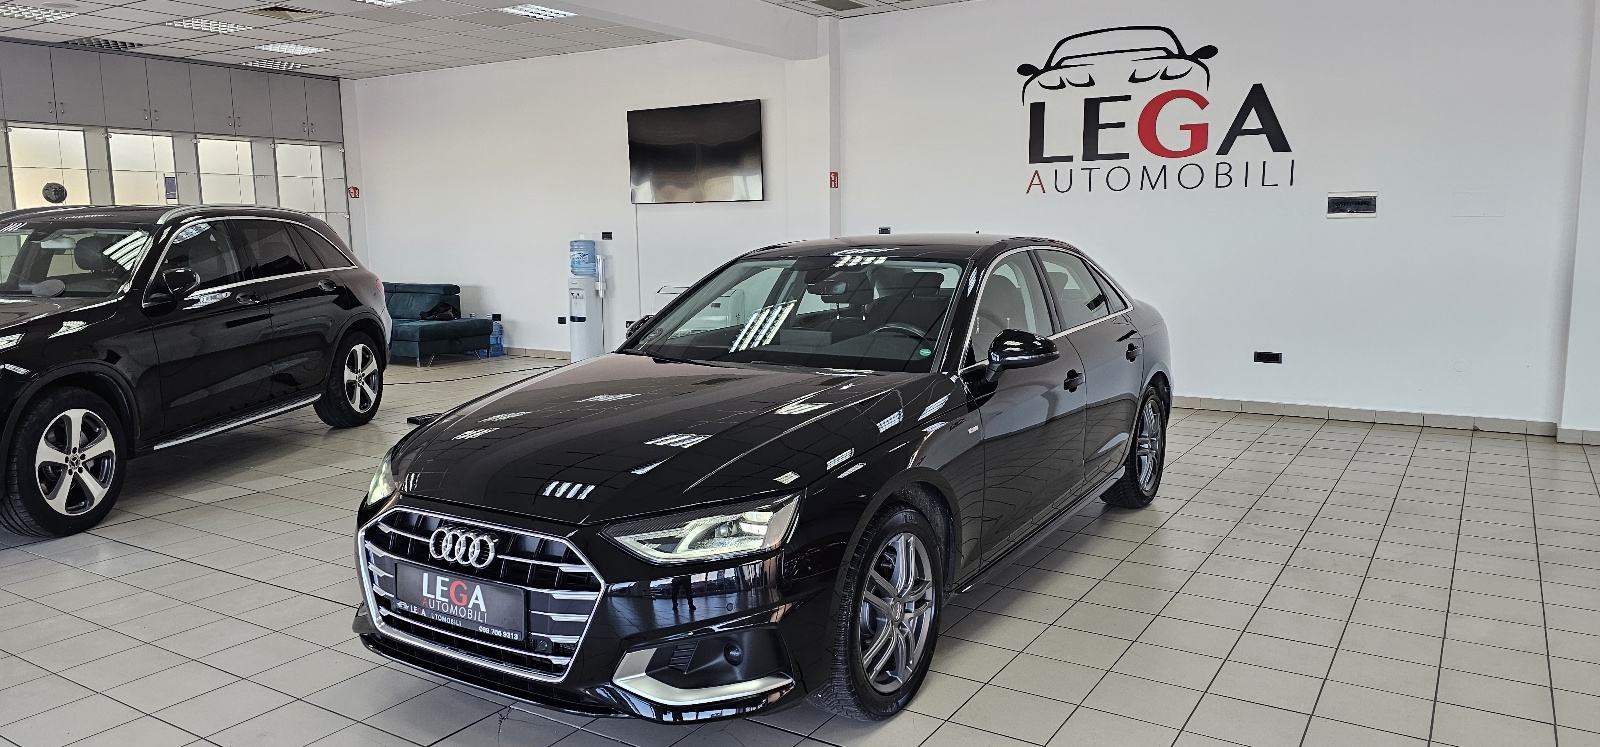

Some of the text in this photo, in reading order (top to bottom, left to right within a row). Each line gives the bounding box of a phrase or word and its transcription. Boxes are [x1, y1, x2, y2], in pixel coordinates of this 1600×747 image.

[1029, 83, 1292, 164] LEGA
[1026, 160, 1295, 195] AUTOMOBILI
[422, 572, 487, 612] LEGA
[421, 596, 488, 624] AUTOMOBILI
[429, 612, 462, 626] UTOMOBILI
